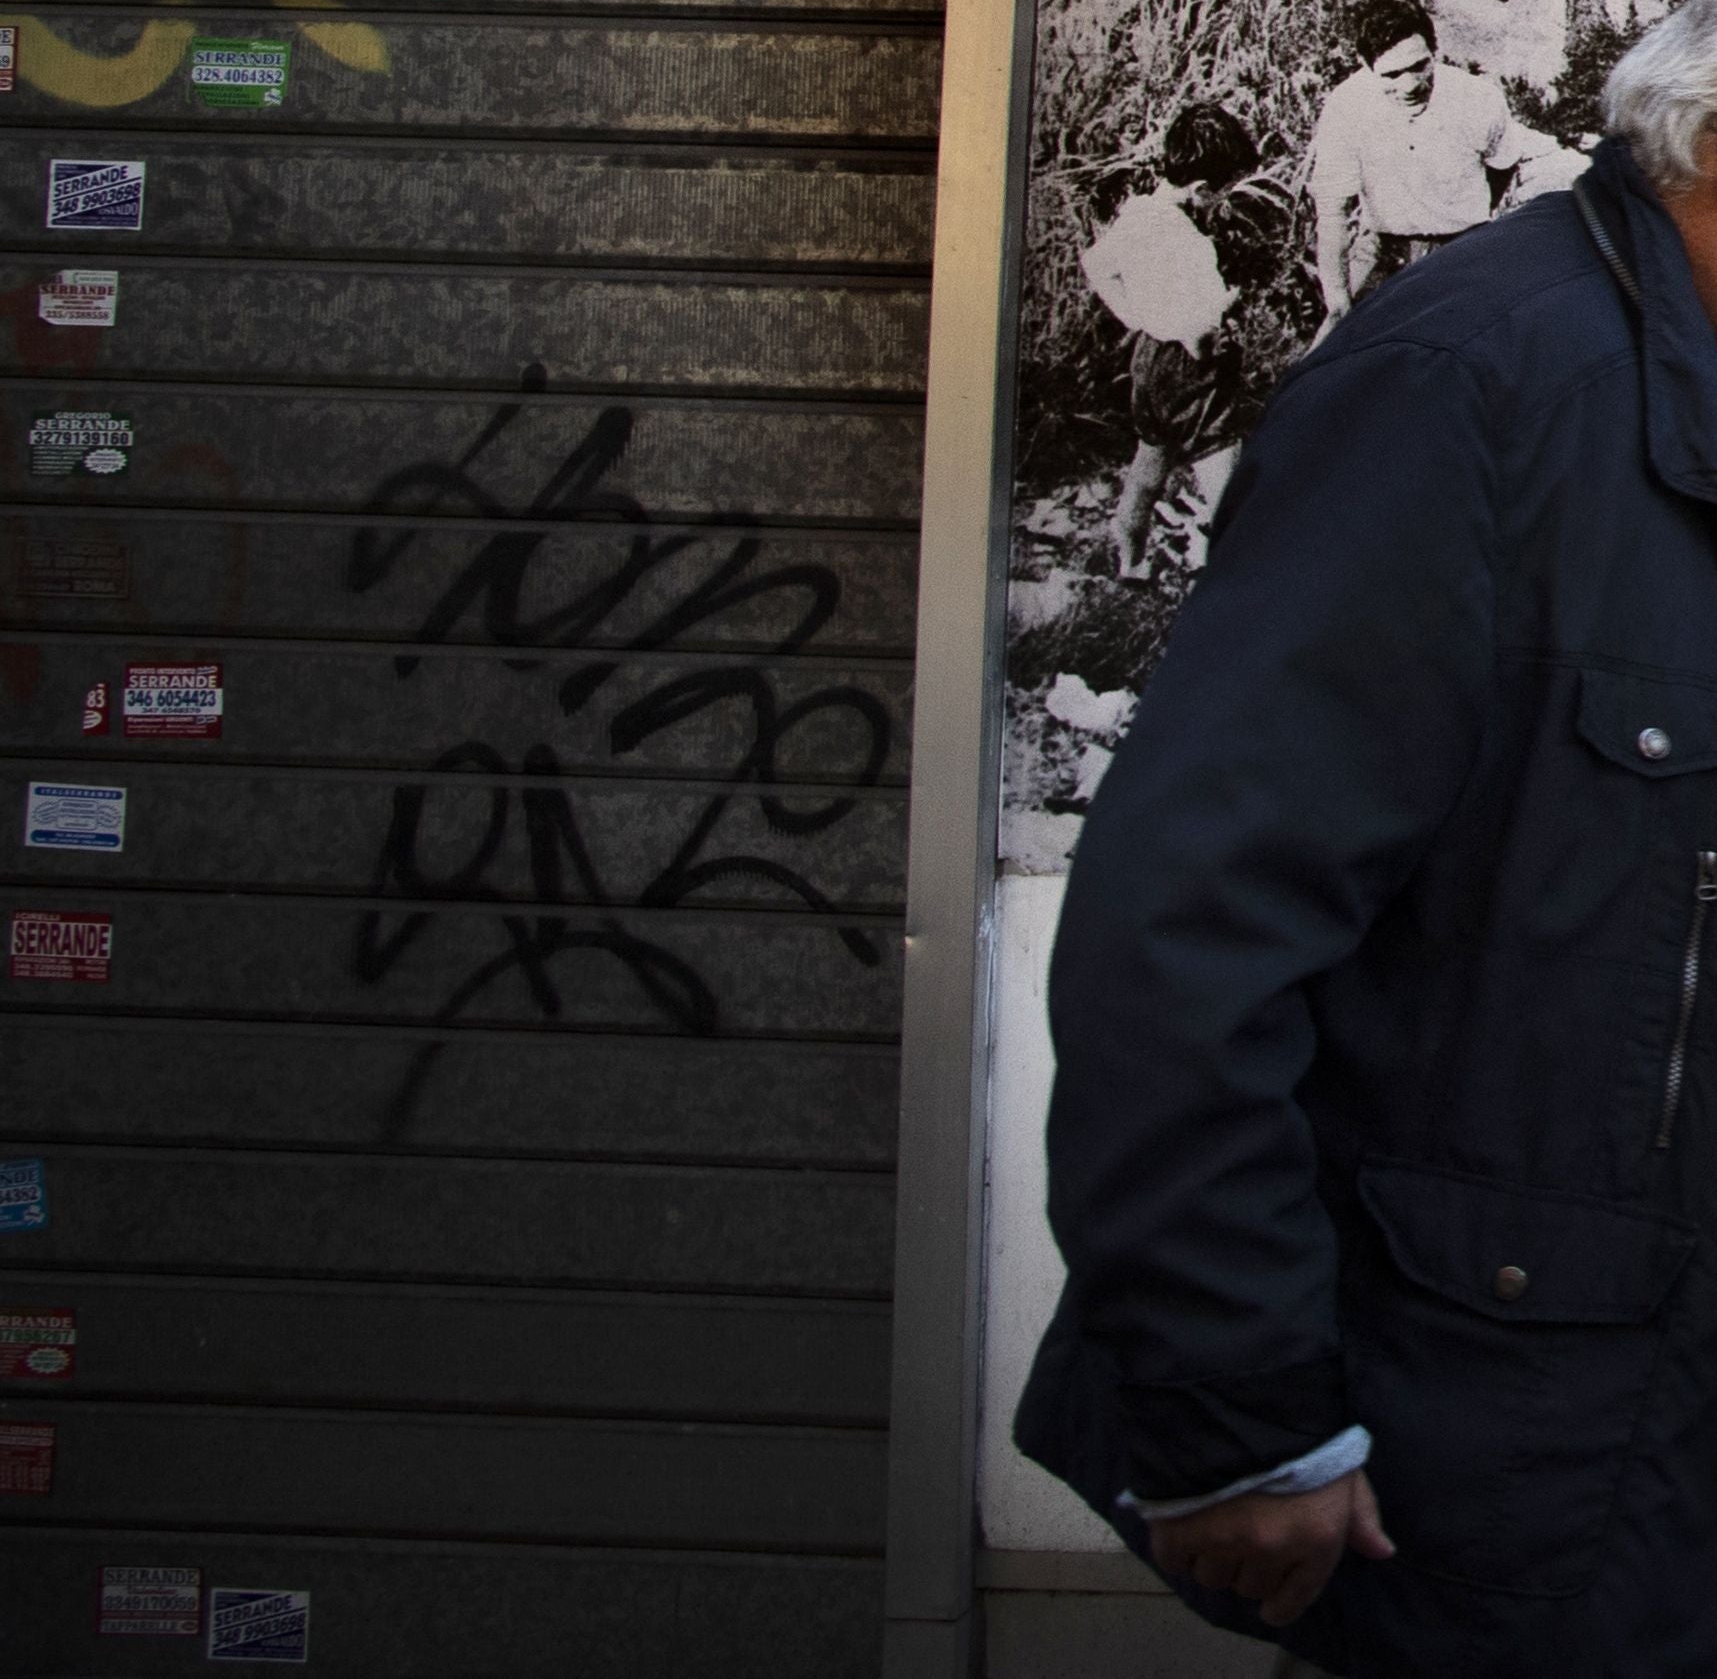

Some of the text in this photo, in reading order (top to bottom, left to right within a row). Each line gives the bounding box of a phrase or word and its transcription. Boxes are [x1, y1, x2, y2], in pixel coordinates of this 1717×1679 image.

[195, 67, 283, 84] 328.4064382
[54, 165, 129, 198] SERRANDE
[80, 182, 142, 211] 9903698
[41, 284, 116, 296] SERRANDE
[55, 412, 112, 420] GREGORIO
[36, 419, 130, 431] SERRANDE
[34, 431, 129, 445] 3279139160
[129, 674, 218, 689] SERRANDE
[127, 690, 217, 707] 346 6054423
[15, 922, 109, 958] SERRANDE
[105, 1569, 197, 1584] SERRANDE
[214, 1595, 293, 1629] SERRANDE
